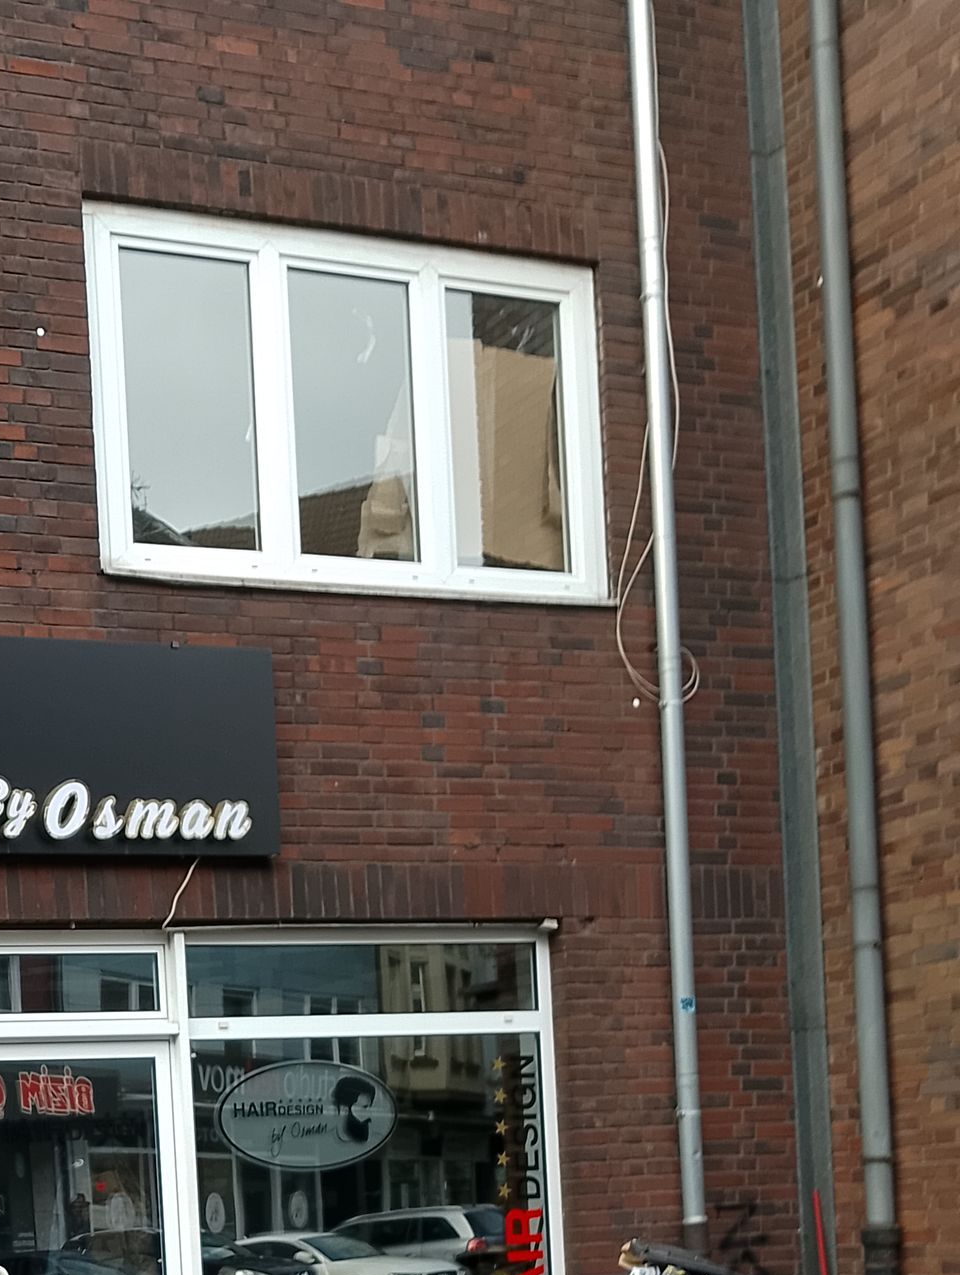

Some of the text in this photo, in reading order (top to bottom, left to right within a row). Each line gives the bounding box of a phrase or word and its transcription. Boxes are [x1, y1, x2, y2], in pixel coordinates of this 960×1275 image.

[43, 778, 253, 841] Osman
[270, 1121, 329, 1158] by Osman
